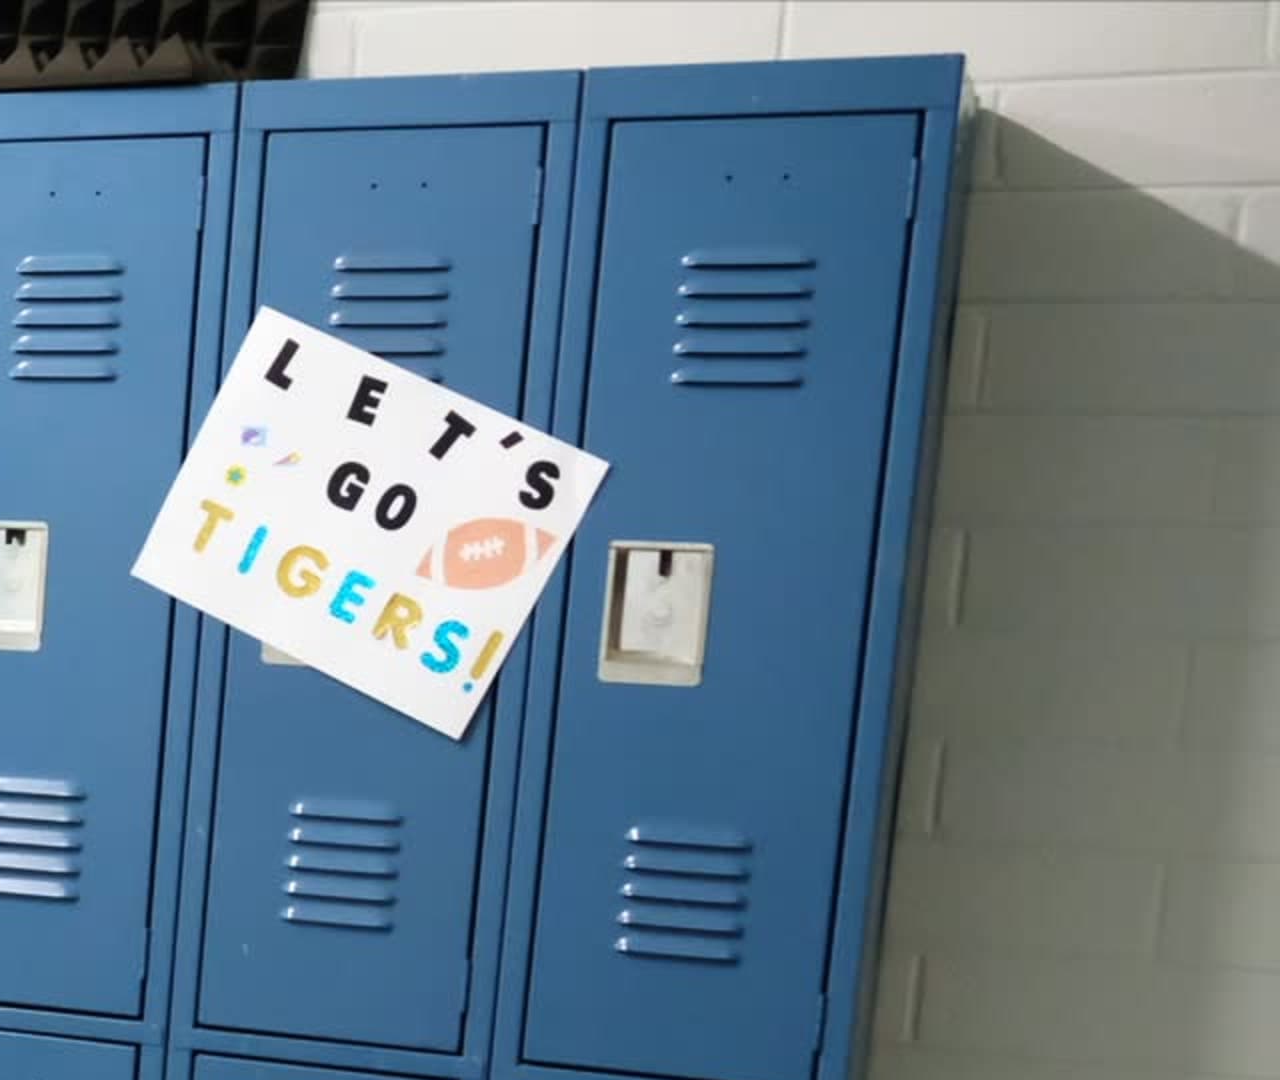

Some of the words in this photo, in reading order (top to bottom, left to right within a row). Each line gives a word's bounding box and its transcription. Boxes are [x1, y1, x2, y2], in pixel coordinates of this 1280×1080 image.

[264, 338, 560, 511] LET'S
[326, 461, 417, 531] GO
[192, 499, 505, 693] TIGERS!
